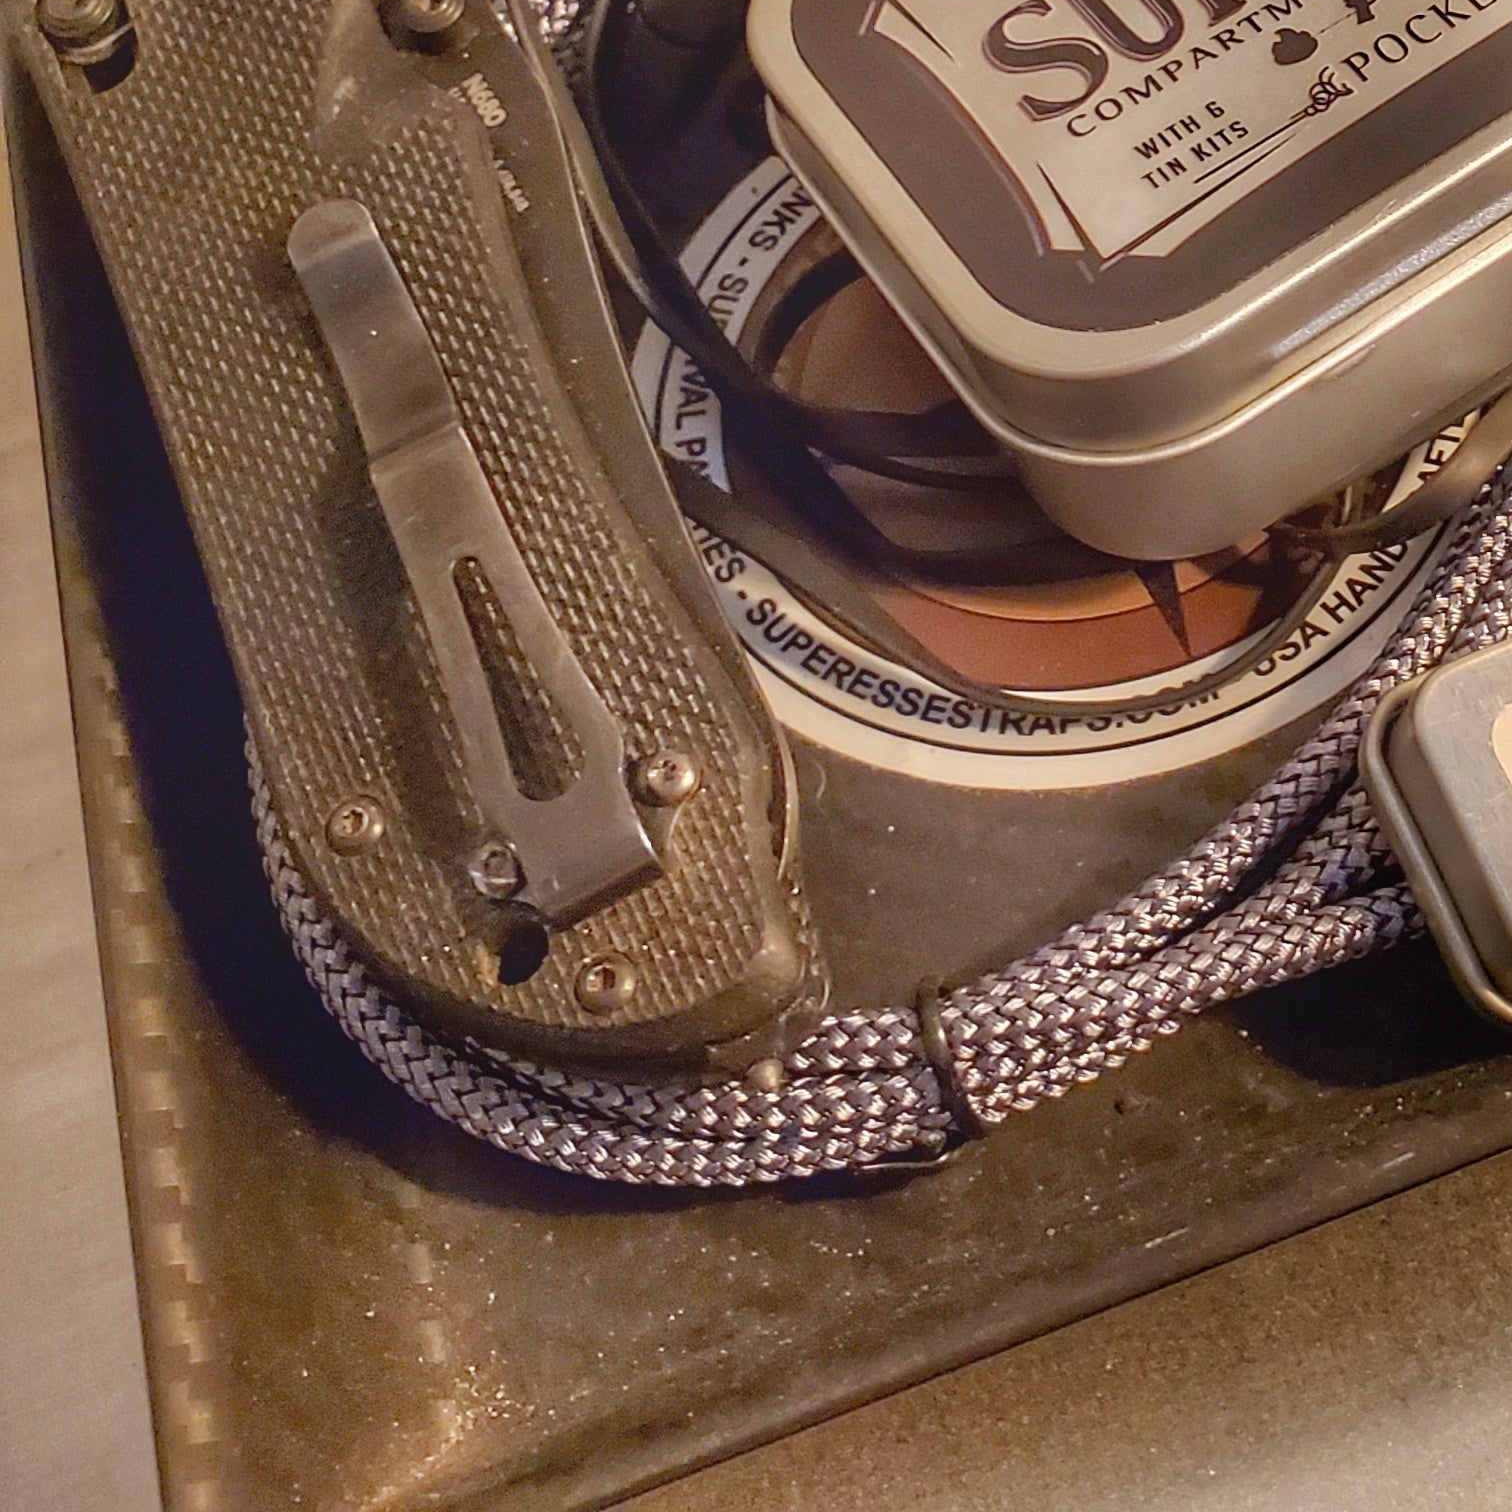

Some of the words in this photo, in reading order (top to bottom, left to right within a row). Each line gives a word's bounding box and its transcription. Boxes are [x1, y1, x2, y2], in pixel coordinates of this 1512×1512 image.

[1133, 113, 1203, 160] WITH
[1209, 100, 1226, 119] 6
[1141, 157, 1189, 189] TIN
[1197, 120, 1249, 162] KITS
